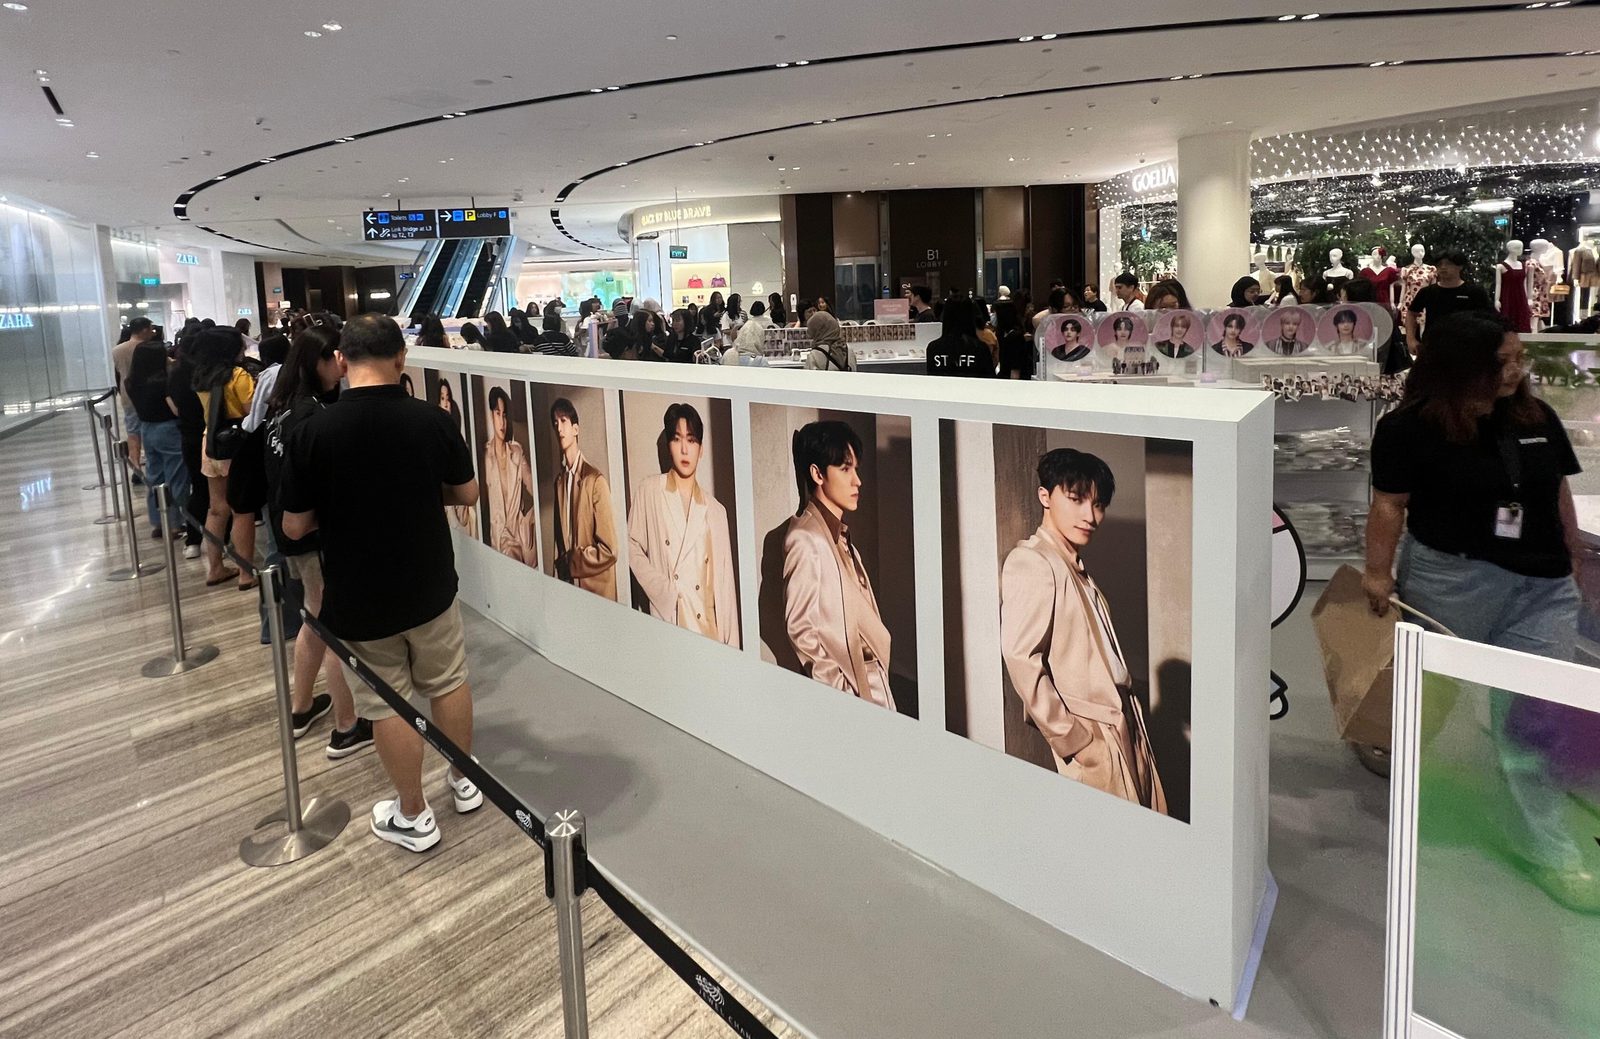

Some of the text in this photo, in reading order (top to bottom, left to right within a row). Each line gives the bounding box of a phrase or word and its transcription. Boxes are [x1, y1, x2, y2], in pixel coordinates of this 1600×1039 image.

[664, 209, 682, 222] BLUE
[683, 205, 712, 219] BRAVE
[175, 252, 200, 265] ZARA
[927, 249, 939, 260] B1
[933, 354, 976, 367] STFF
